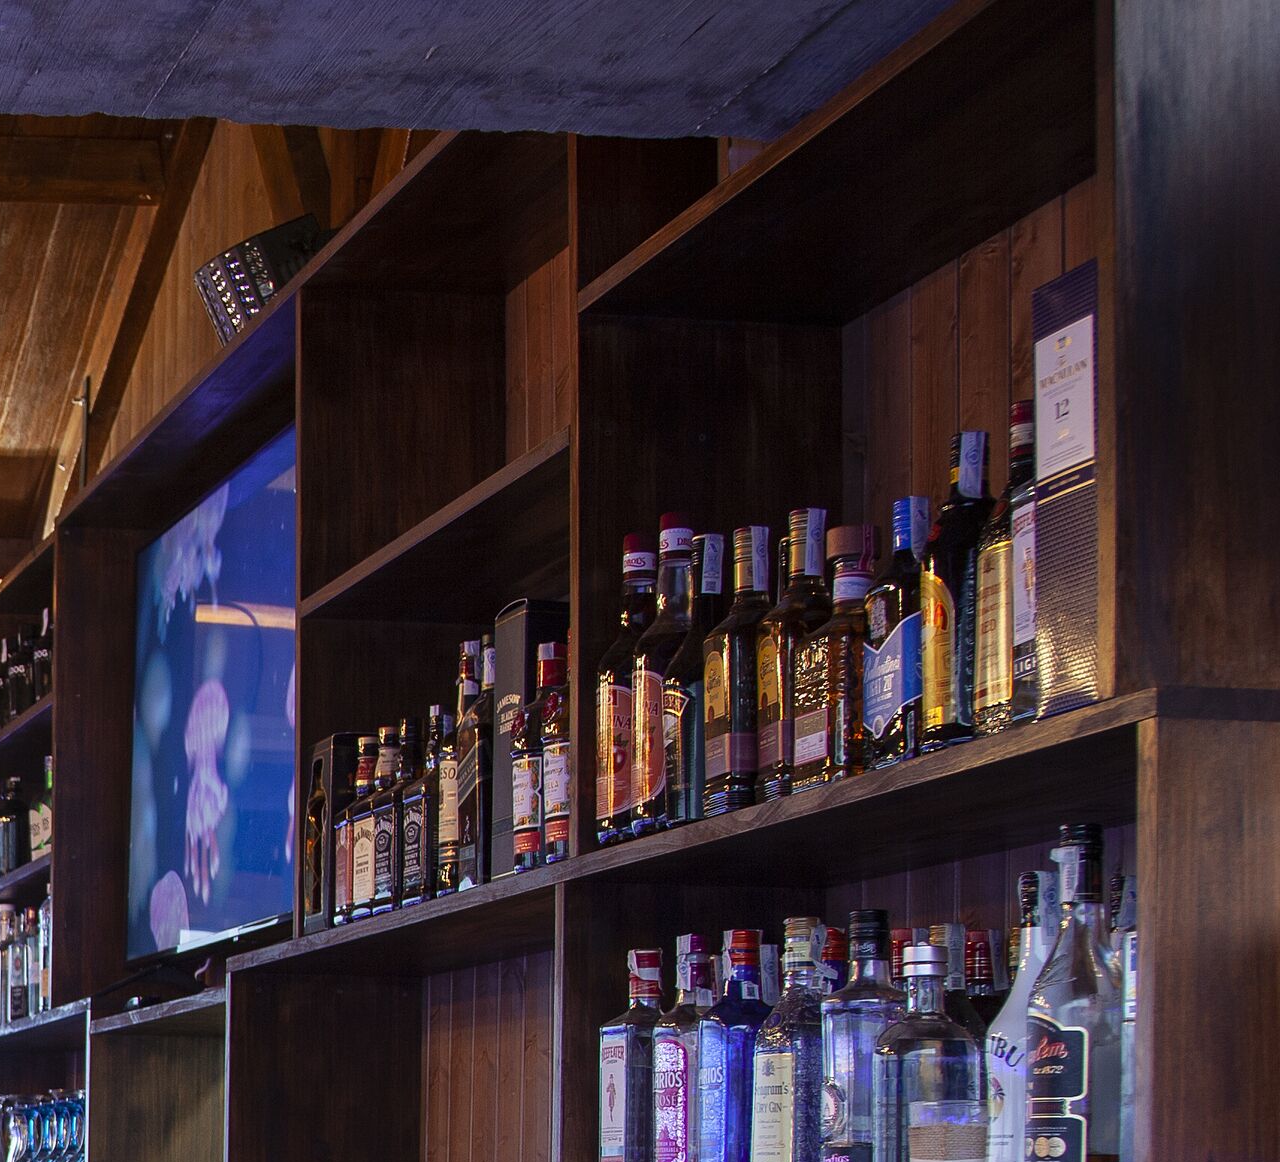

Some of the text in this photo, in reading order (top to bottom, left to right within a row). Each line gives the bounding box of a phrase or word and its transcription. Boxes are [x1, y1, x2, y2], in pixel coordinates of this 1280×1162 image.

[1054, 398, 1070, 420] 12
[496, 694, 521, 713] JAMESON
[499, 720, 515, 734] BARRE
[654, 1071, 683, 1089] ARIOS
[699, 1066, 723, 1084] RIOS
[768, 1101, 783, 1113] GIN
